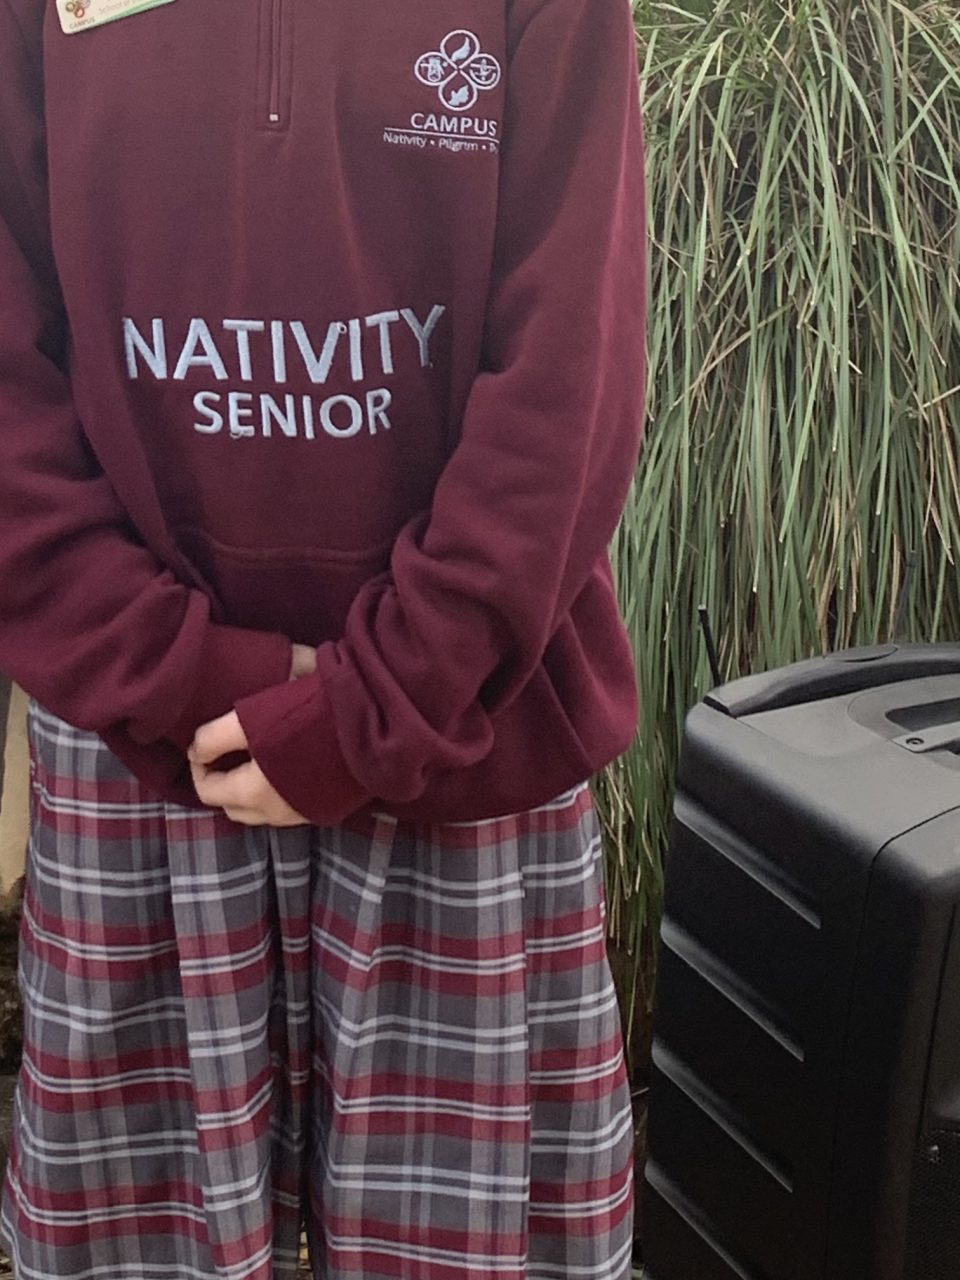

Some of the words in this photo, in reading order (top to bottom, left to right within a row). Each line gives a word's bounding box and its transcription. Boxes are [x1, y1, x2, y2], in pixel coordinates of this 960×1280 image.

[383, 132, 427, 148] Nativity
[439, 138, 479, 152] Pilgrim
[410, 113, 497, 137] CAMPUS
[122, 304, 445, 384] NATIVITY
[193, 388, 392, 440] SENIOR
